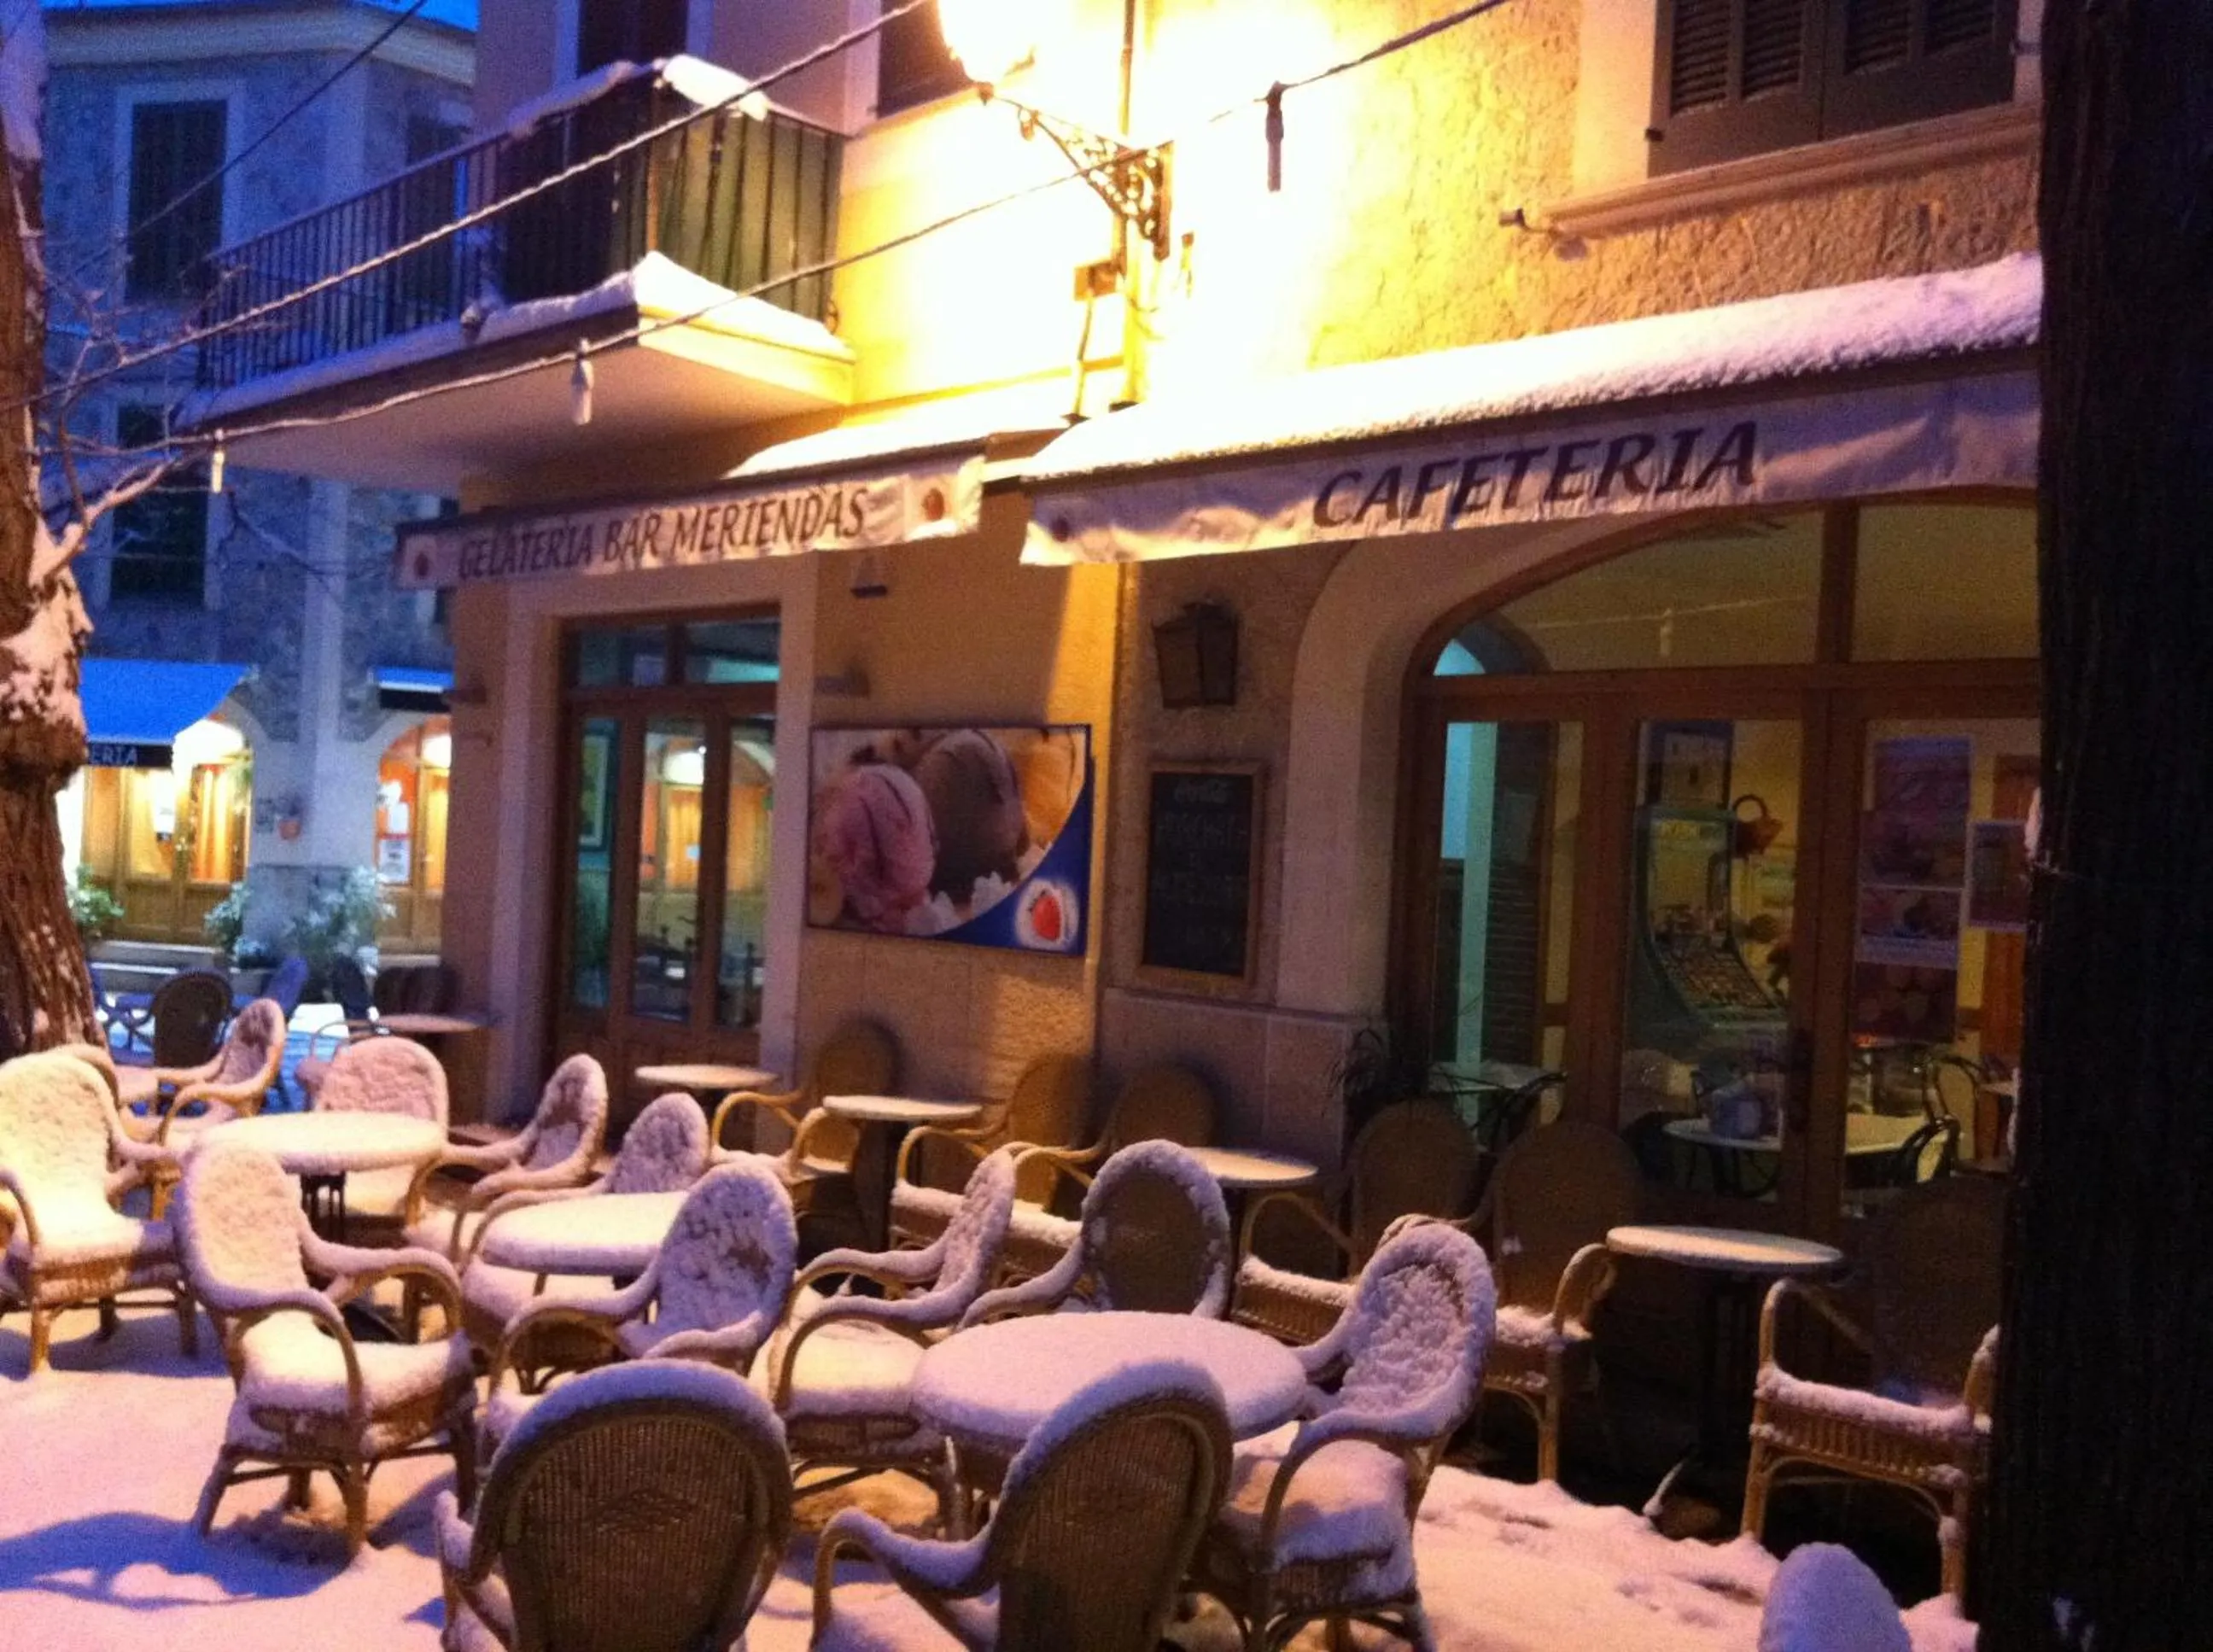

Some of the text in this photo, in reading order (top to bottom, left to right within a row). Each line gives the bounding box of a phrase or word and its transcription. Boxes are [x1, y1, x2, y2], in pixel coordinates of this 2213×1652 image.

[1312, 420, 1759, 527] CAFETERIA
[604, 514, 661, 569] BAR
[671, 487, 867, 553] MERIENDAS
